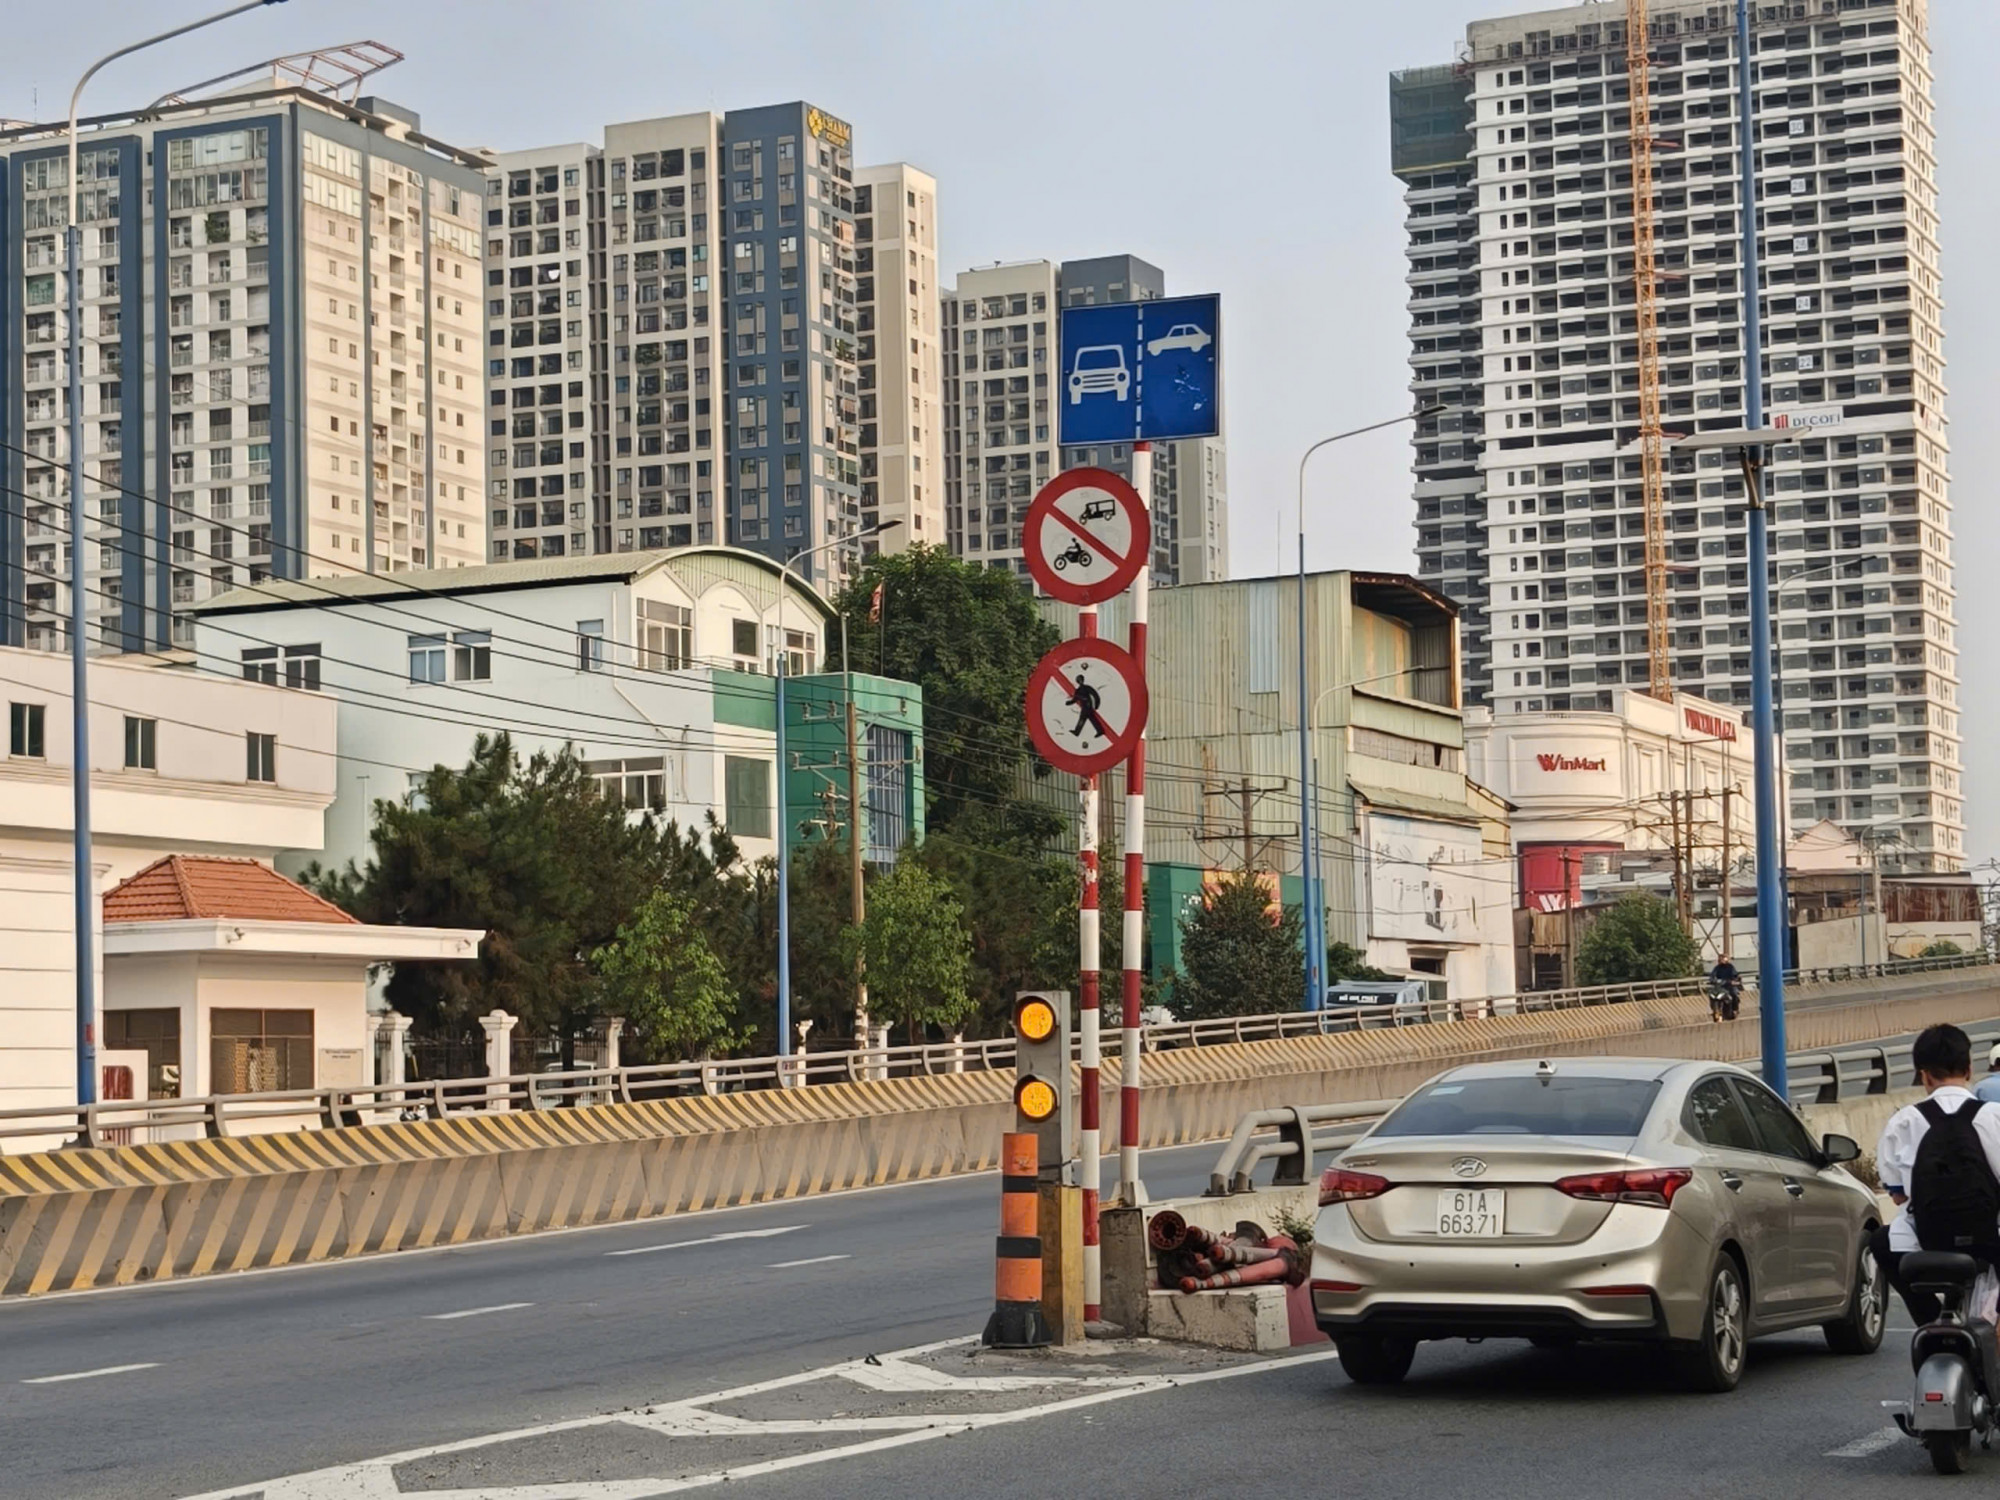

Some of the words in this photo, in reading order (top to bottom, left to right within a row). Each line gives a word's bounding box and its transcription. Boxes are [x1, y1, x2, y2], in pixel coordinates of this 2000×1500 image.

[1537, 753, 1606, 771] WinMart
[1454, 1192, 1487, 1212] 61A
[1440, 1214, 1497, 1234] 663.71
